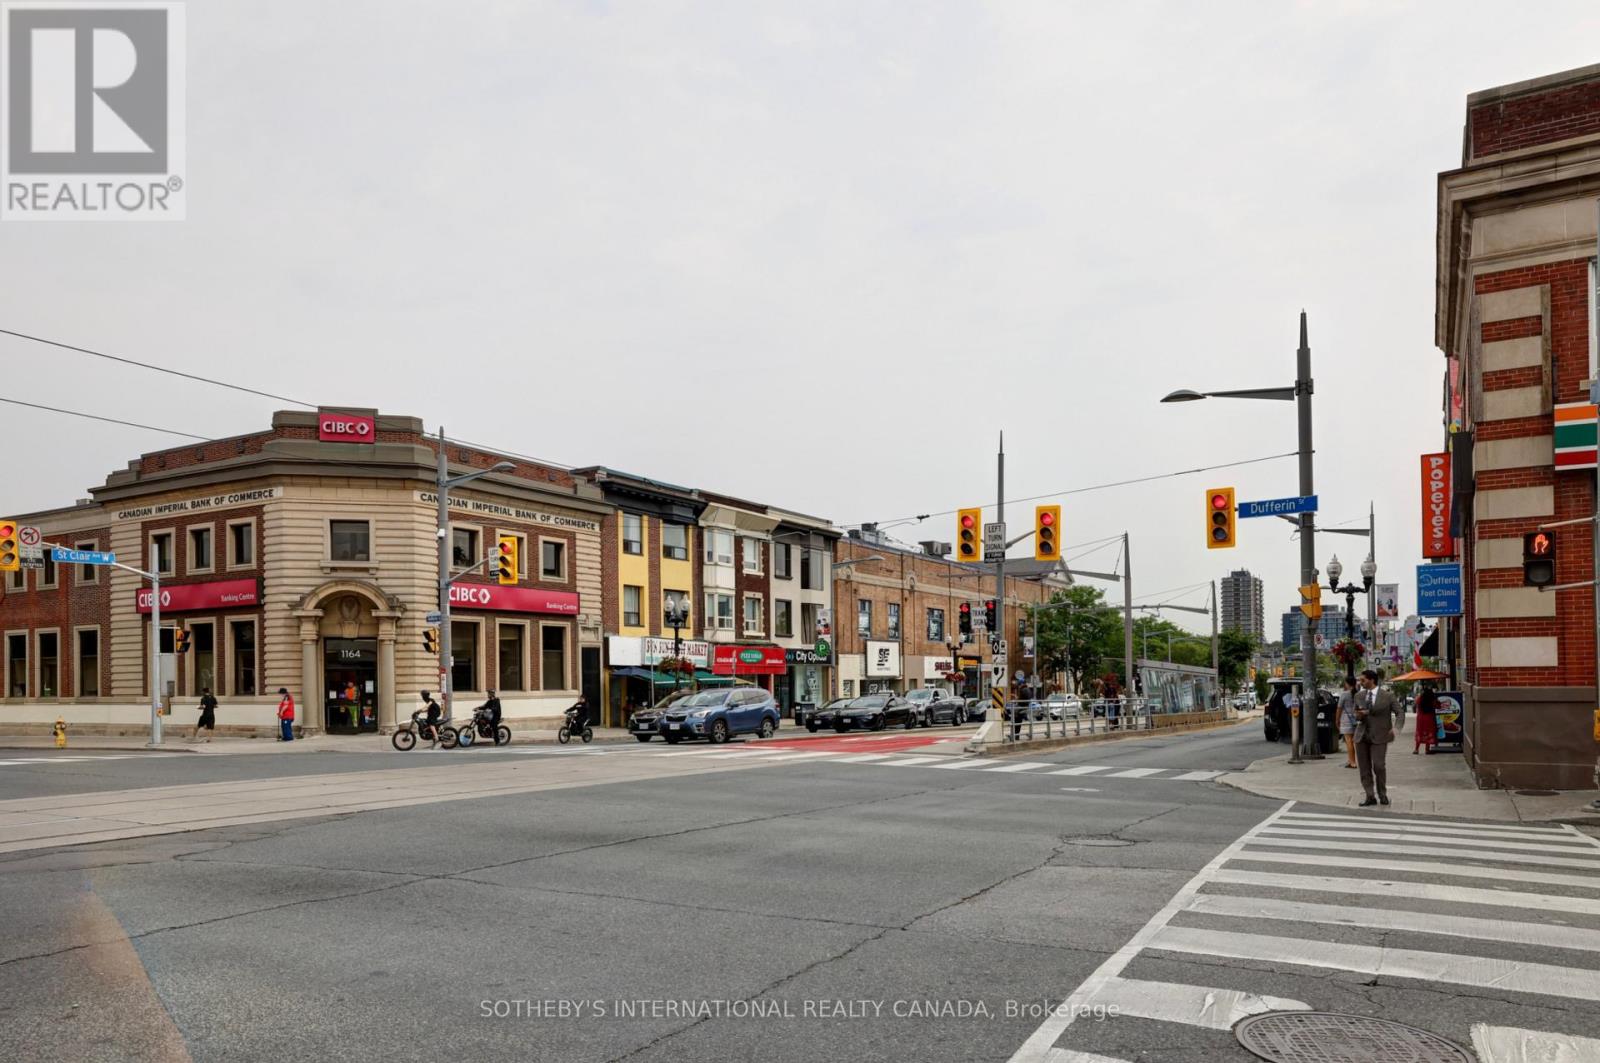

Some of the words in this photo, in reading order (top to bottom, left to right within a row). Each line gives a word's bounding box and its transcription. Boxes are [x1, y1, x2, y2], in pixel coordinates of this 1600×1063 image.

[322, 420, 356, 434] CIBC
[118, 507, 153, 520] CANADIAN
[155, 503, 188, 514] IMPERIAL
[190, 499, 211, 509] BANK
[214, 496, 226, 506] OF
[228, 489, 274, 504] COMMERCE
[1250, 500, 1296, 514] Dufferin
[420, 493, 468, 508] CANDIAN
[472, 502, 513, 517] IMPERIAL
[515, 509, 537, 521] BANK
[540, 514, 551, 522] OF
[554, 516, 596, 531] COMMERCE
[988, 525, 1002, 533] LEFT
[57, 550, 68, 560] St
[69, 551, 91, 561] Clair
[101, 554, 110, 562] W
[1419, 574, 1460, 587] Dufferin
[221, 594, 239, 602] Banking
[238, 592, 255, 601] Centre
[449, 586, 478, 602] CIBC
[1437, 588, 1457, 597] Clinic
[138, 593, 154, 608] CIB
[546, 602, 563, 611] Banking
[563, 603, 578, 611] Centre
[341, 649, 361, 659] 1164
[686, 642, 708, 657] MARKET
[819, 644, 826, 652] P
[795, 650, 808, 663] City
